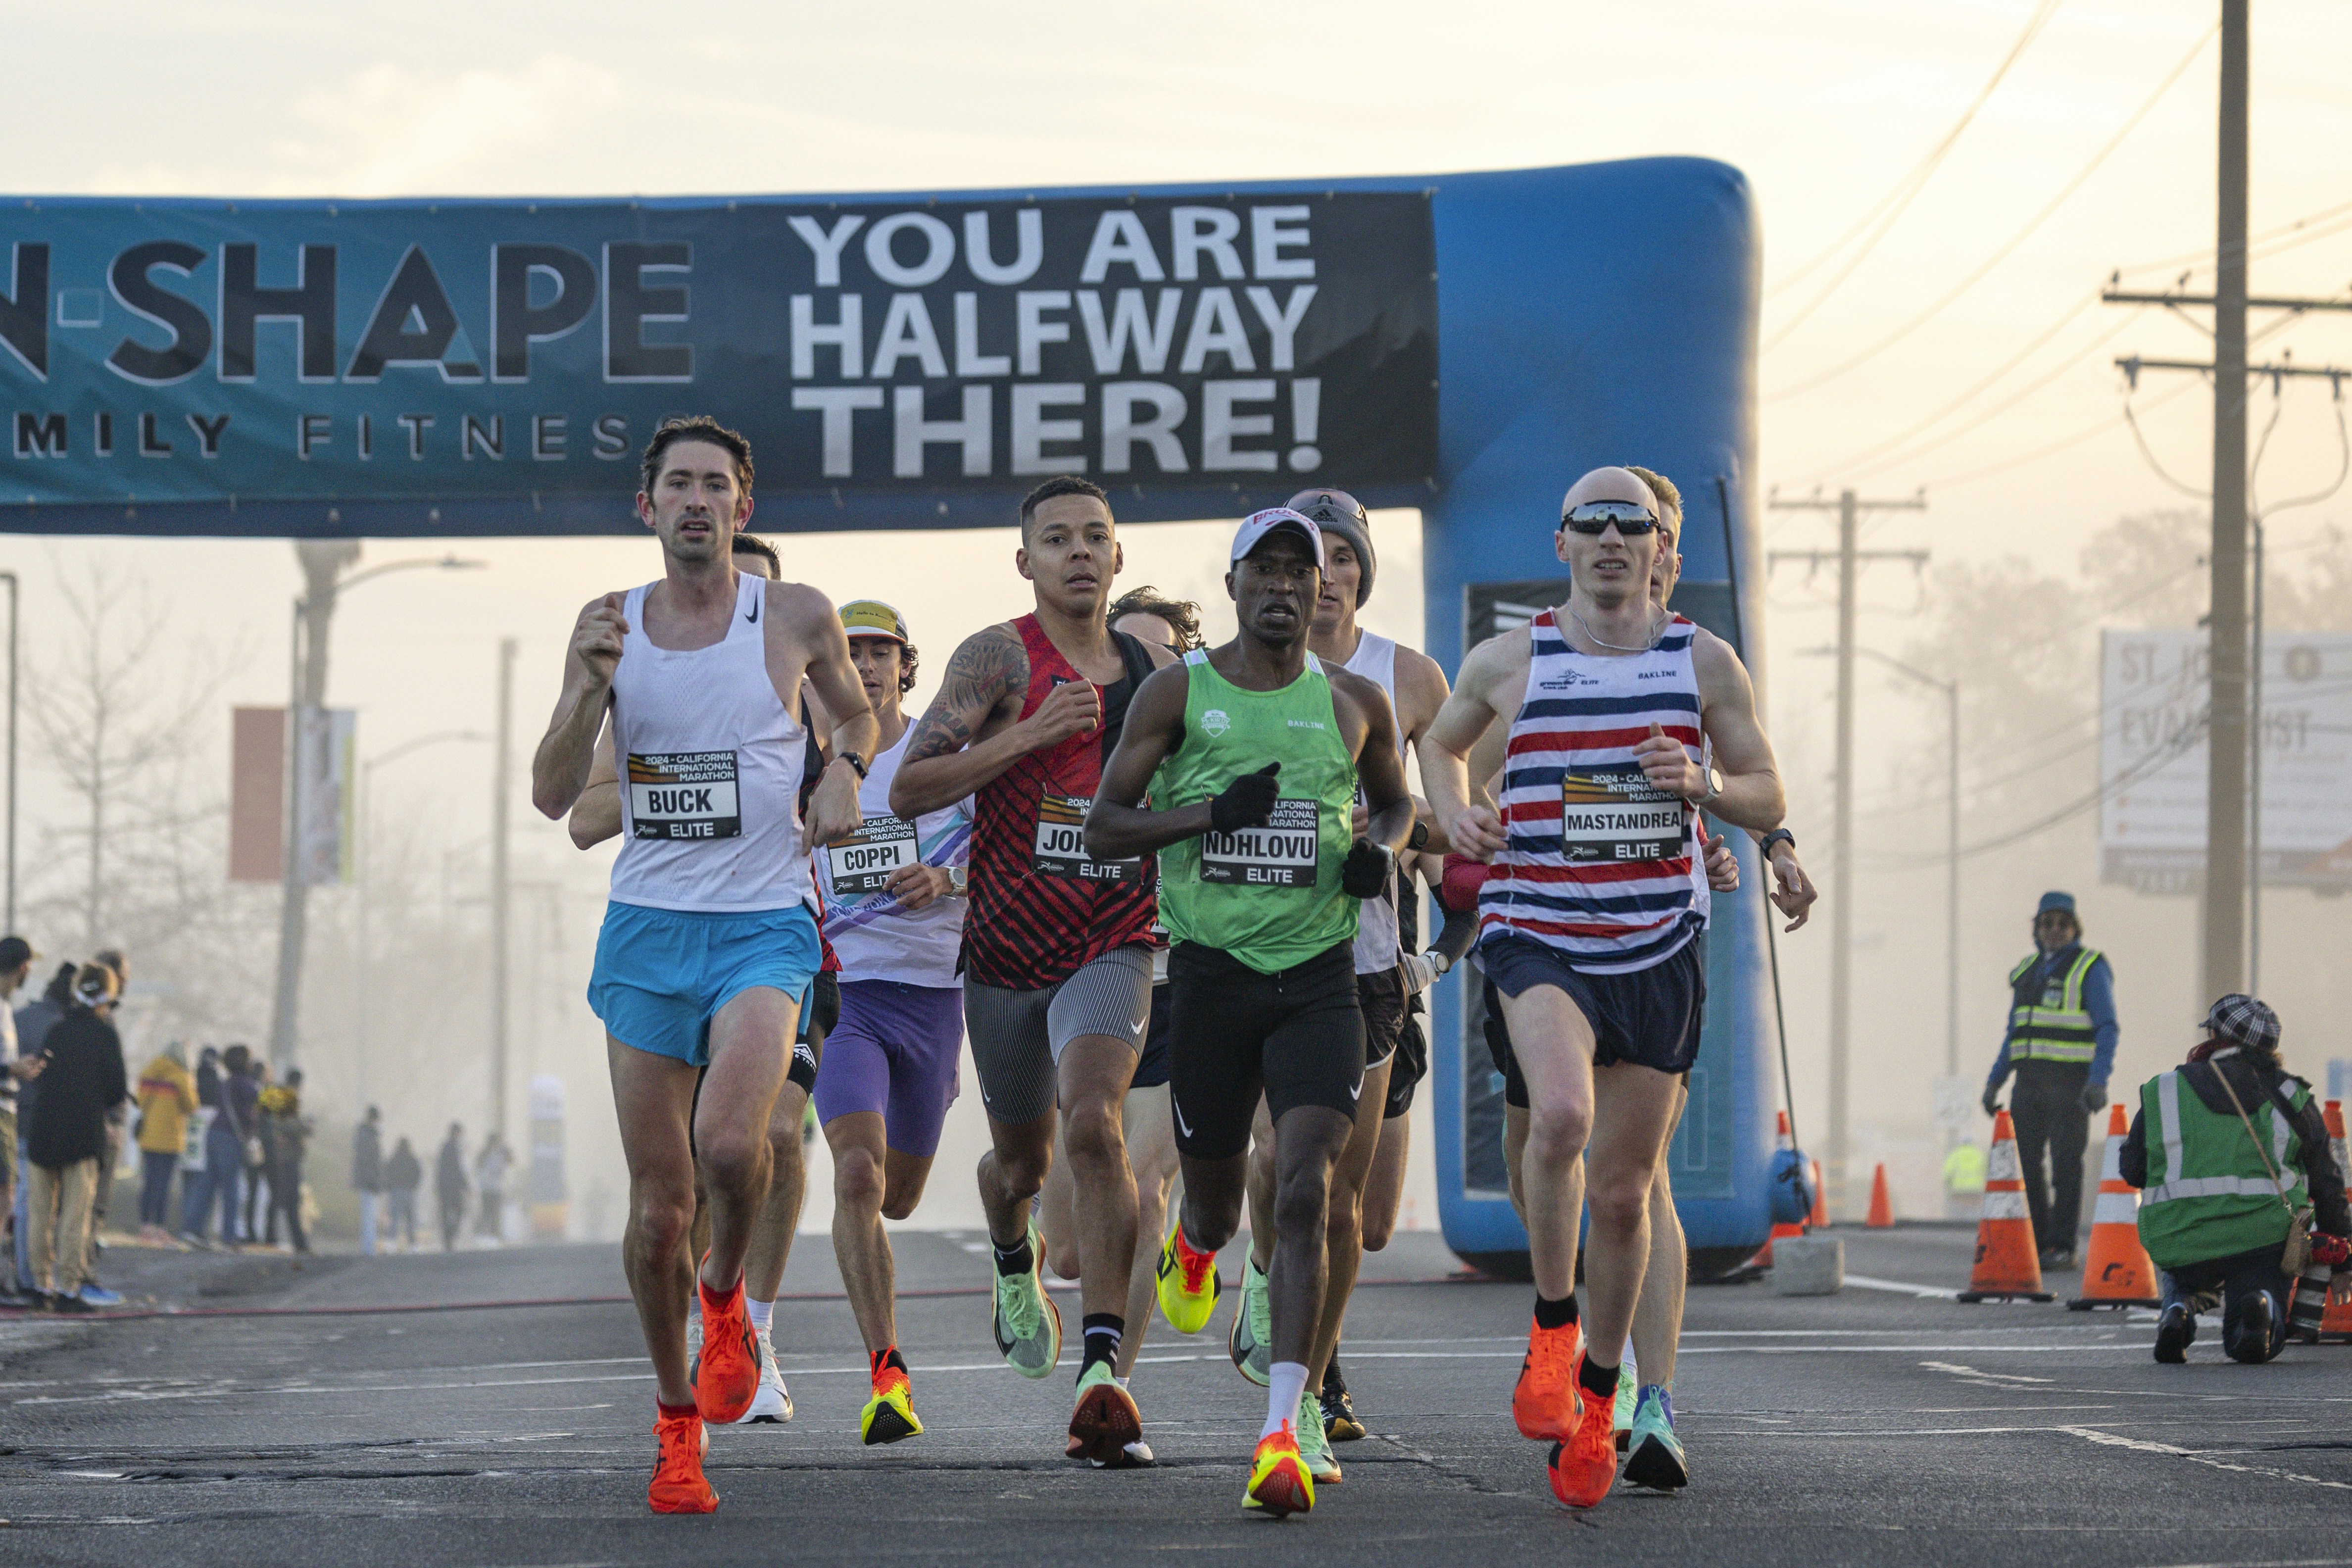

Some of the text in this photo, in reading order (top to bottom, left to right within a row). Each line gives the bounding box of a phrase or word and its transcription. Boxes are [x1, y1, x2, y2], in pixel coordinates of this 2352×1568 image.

[787, 205, 1316, 286] YOU ARE
[790, 285, 1319, 379] HALFWAY
[792, 378, 1323, 478] THERE!
[298, 414, 681, 460] FITNES
[1638, 671, 1677, 680] BAKLINE
[1288, 720, 1325, 730] BAKLINE
[645, 755, 669, 765] 2024
[676, 753, 734, 764] CALIFORNIA
[659, 763, 734, 774] INTERNATIONAL
[680, 771, 735, 782] MARATHON
[1592, 775, 1618, 784] 2024
[648, 788, 714, 813] BUCK
[1067, 798, 1090, 807] 2024
[1629, 792, 1679, 802] MARATHO
[1275, 801, 1317, 810] LIFORNIA
[1271, 810, 1316, 819] NATIONAL
[867, 817, 901, 827] CALIFOR
[1568, 812, 1681, 831] MASTANDREA
[670, 822, 714, 837] ELITE
[854, 823, 914, 836] INTERNATIONAL
[871, 831, 915, 841] MARATHON
[1205, 833, 1314, 859] NDHLOVU
[1615, 843, 1660, 859] ELITE
[844, 846, 900, 871] COPPI
[1080, 863, 1122, 878] ELITE
[1247, 868, 1293, 883] ELITE
[863, 875, 890, 888] ELIT
